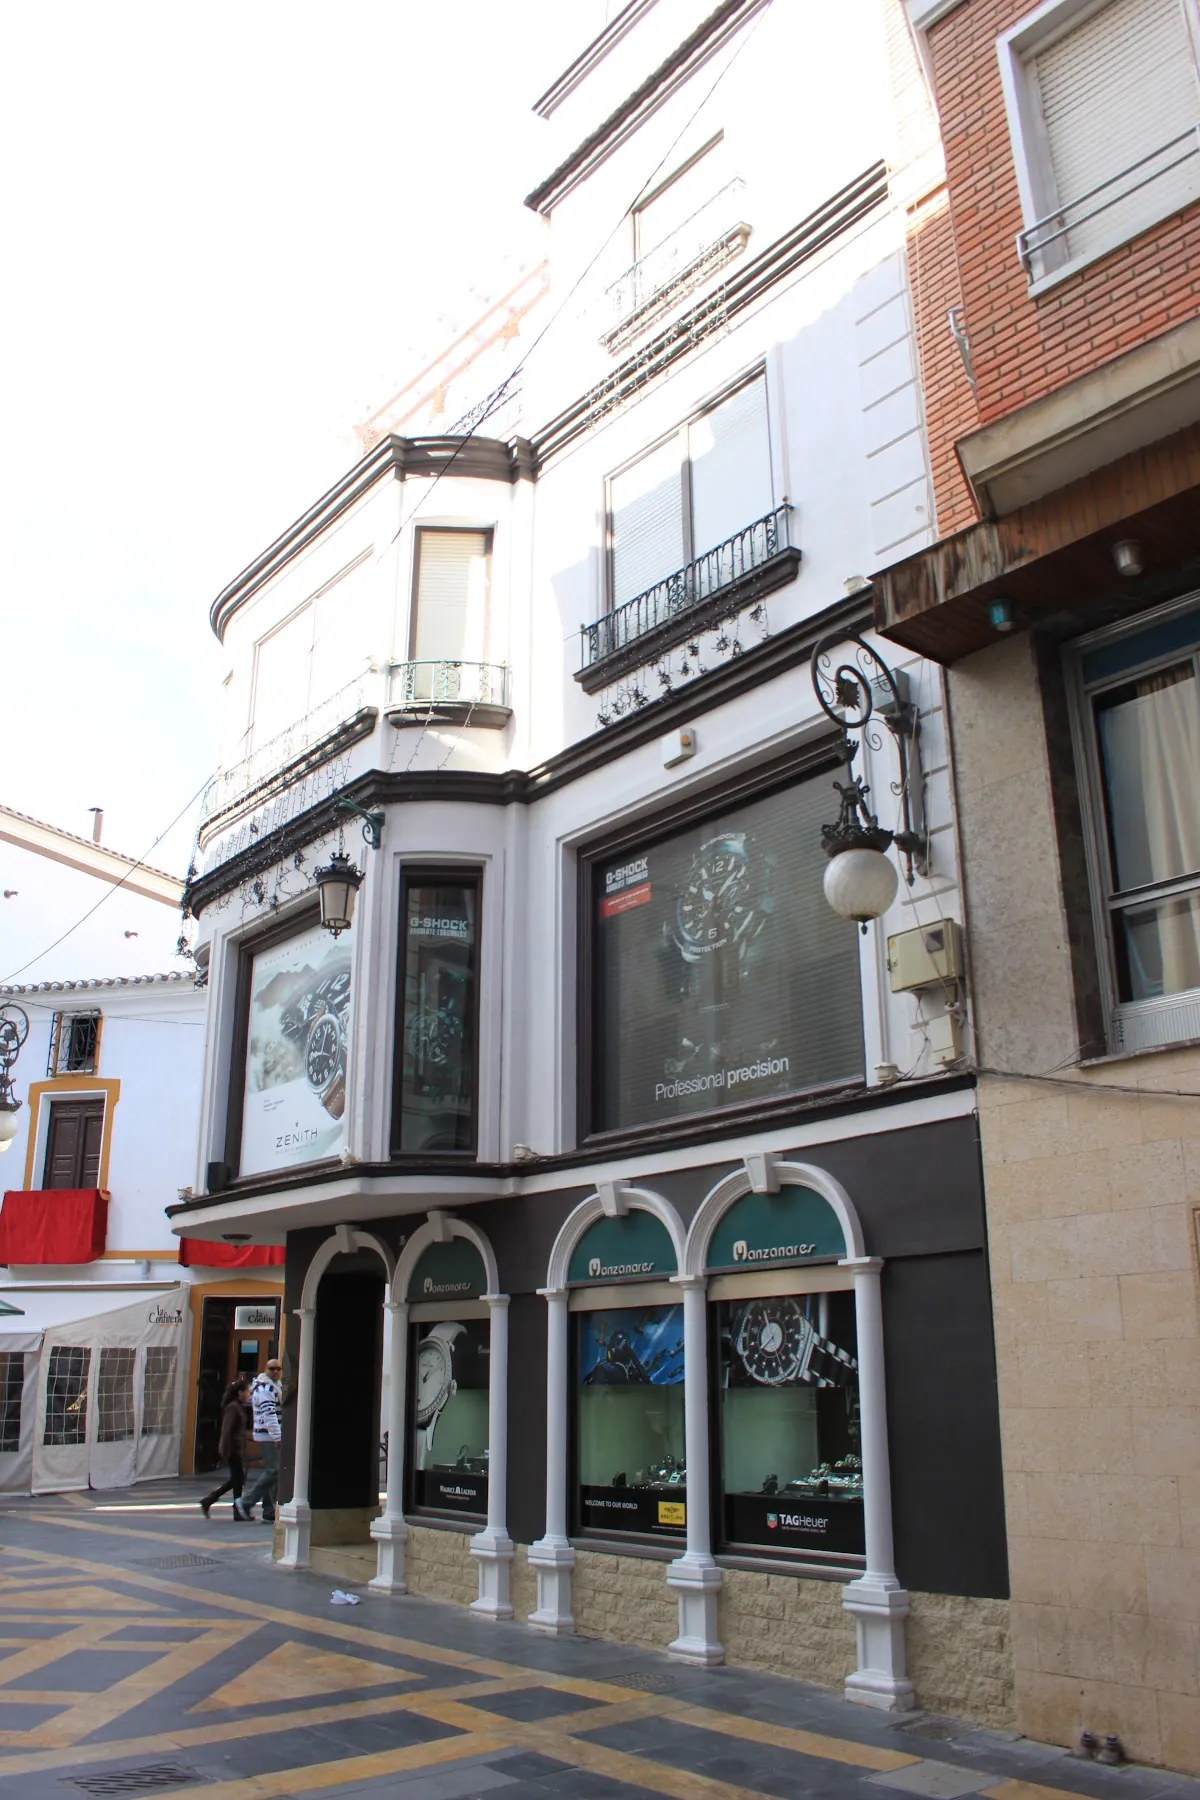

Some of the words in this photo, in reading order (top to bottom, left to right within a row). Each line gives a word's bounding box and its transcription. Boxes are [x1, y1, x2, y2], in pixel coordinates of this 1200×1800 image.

[605, 856, 649, 885] G-SHOCK
[410, 917, 468, 931] G-SHOCK
[655, 1070, 725, 1101] Professional
[727, 1057, 789, 1089] precision
[276, 1127, 318, 1148] ZENITH
[733, 1240, 816, 1261] Manzanares
[588, 1257, 655, 1277] Manzanares
[423, 1277, 472, 1294] Manzanares
